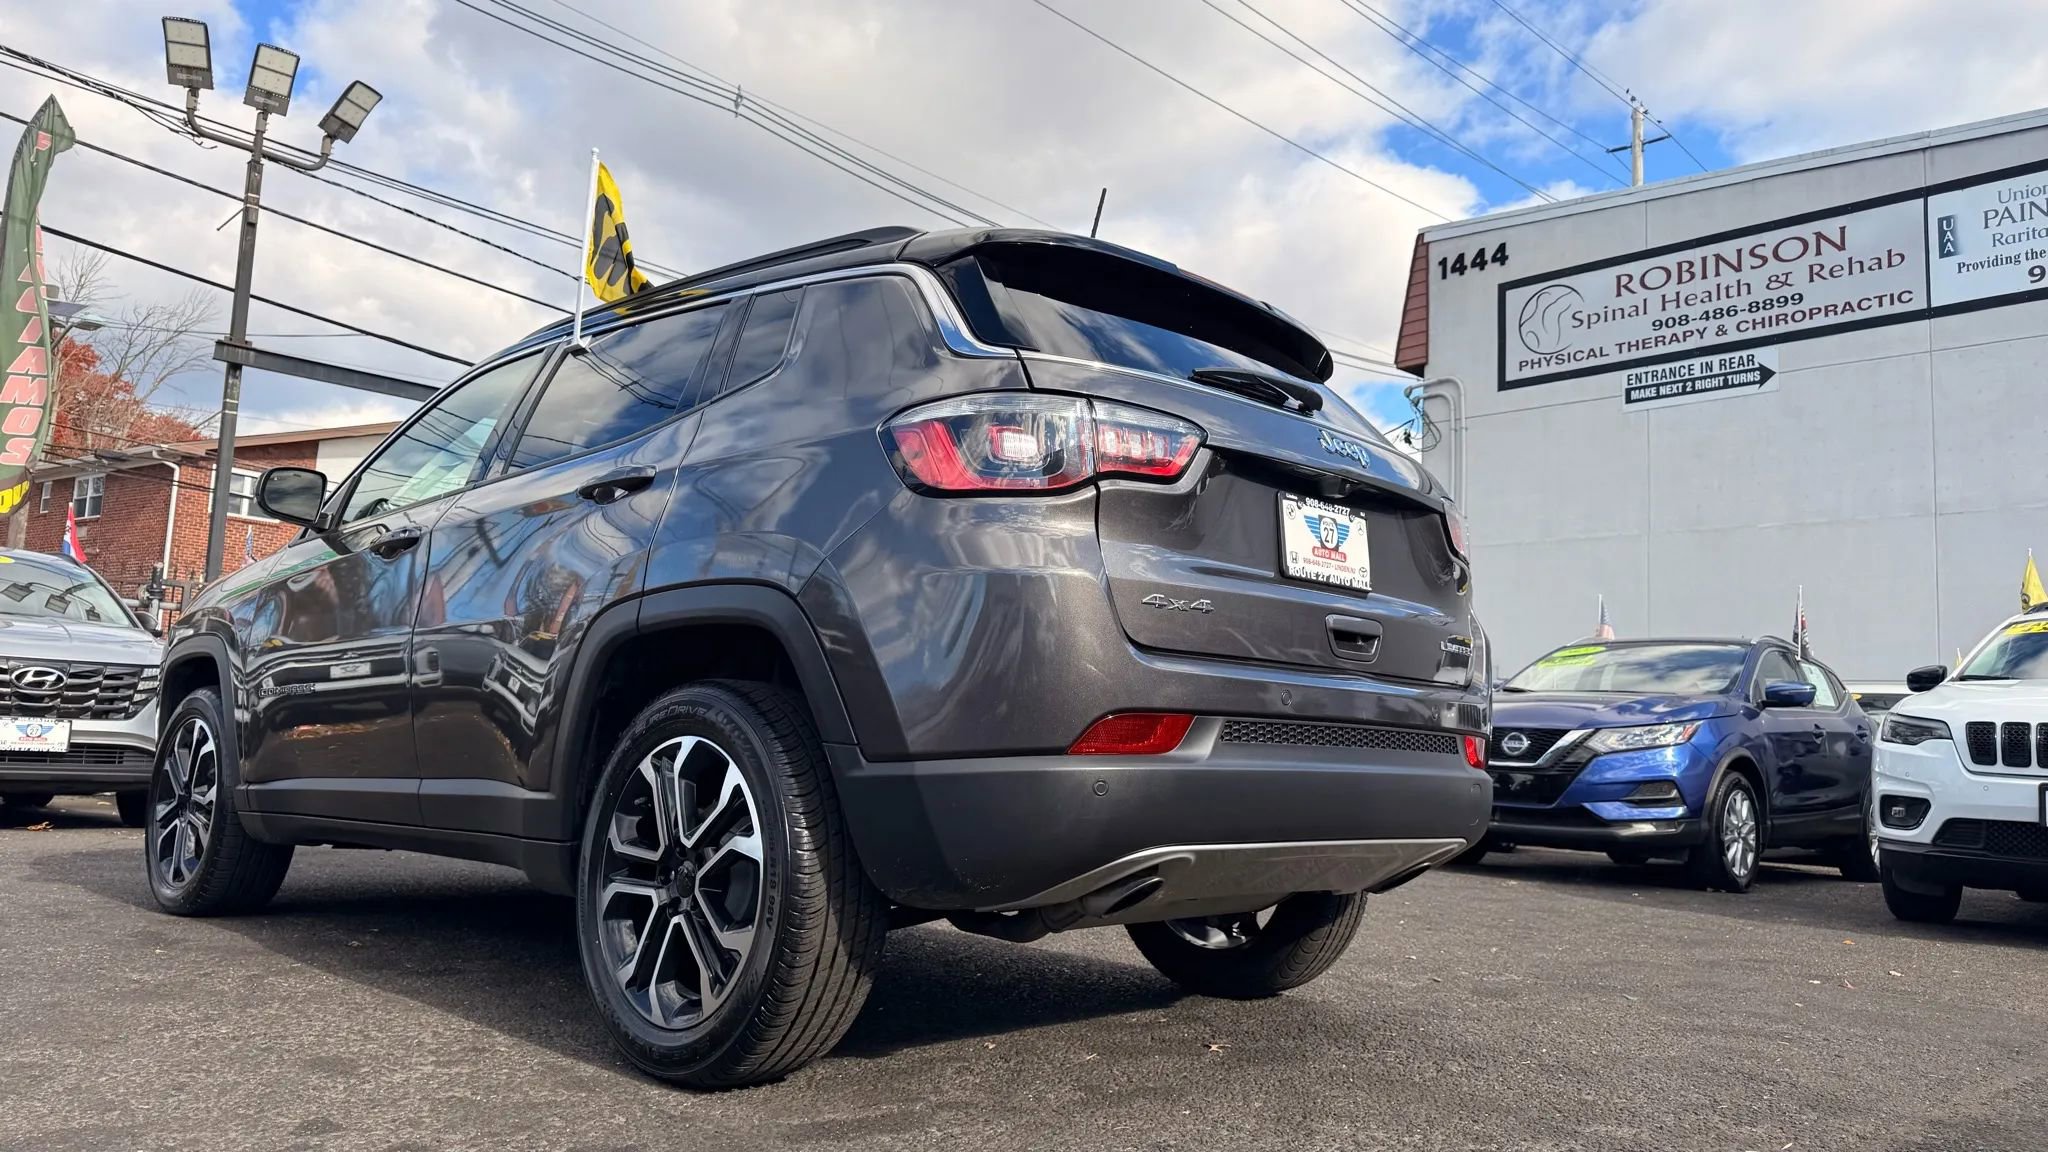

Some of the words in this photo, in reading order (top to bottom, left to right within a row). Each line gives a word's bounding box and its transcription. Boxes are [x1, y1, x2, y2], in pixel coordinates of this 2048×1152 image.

[1438, 242, 1509, 280] 1444
[1615, 225, 1847, 297] ROBINSON
[1957, 252, 2021, 274] Providing
[2025, 248, 2047, 262] the
[1572, 298, 1648, 330] Spinal
[1661, 279, 1751, 313] Health
[1766, 271, 1794, 291] &
[1808, 248, 1906, 283] Rehab
[1651, 292, 1804, 331] 908-486-8899
[1519, 345, 1609, 372] PHYSICAL
[1615, 326, 1708, 354] THERAPY
[1715, 324, 1729, 337] &
[1736, 290, 1914, 333] CHIROPRACTIC
[1626, 363, 1695, 386] ENTRANCE
[1700, 360, 1713, 375] IN
[1719, 354, 1755, 372] REAR
[1630, 388, 1657, 401] MAKE
[1659, 383, 1683, 395] NEXT
[1685, 381, 1692, 392] 2
[1695, 375, 1725, 391] RIGHT
[1727, 370, 1760, 386] TURNS
[1319, 429, 1369, 468] Jeep
[1323, 526, 1334, 545] 27
[1289, 565, 1317, 580] ROUTE
[1330, 574, 1351, 586] AUTO
